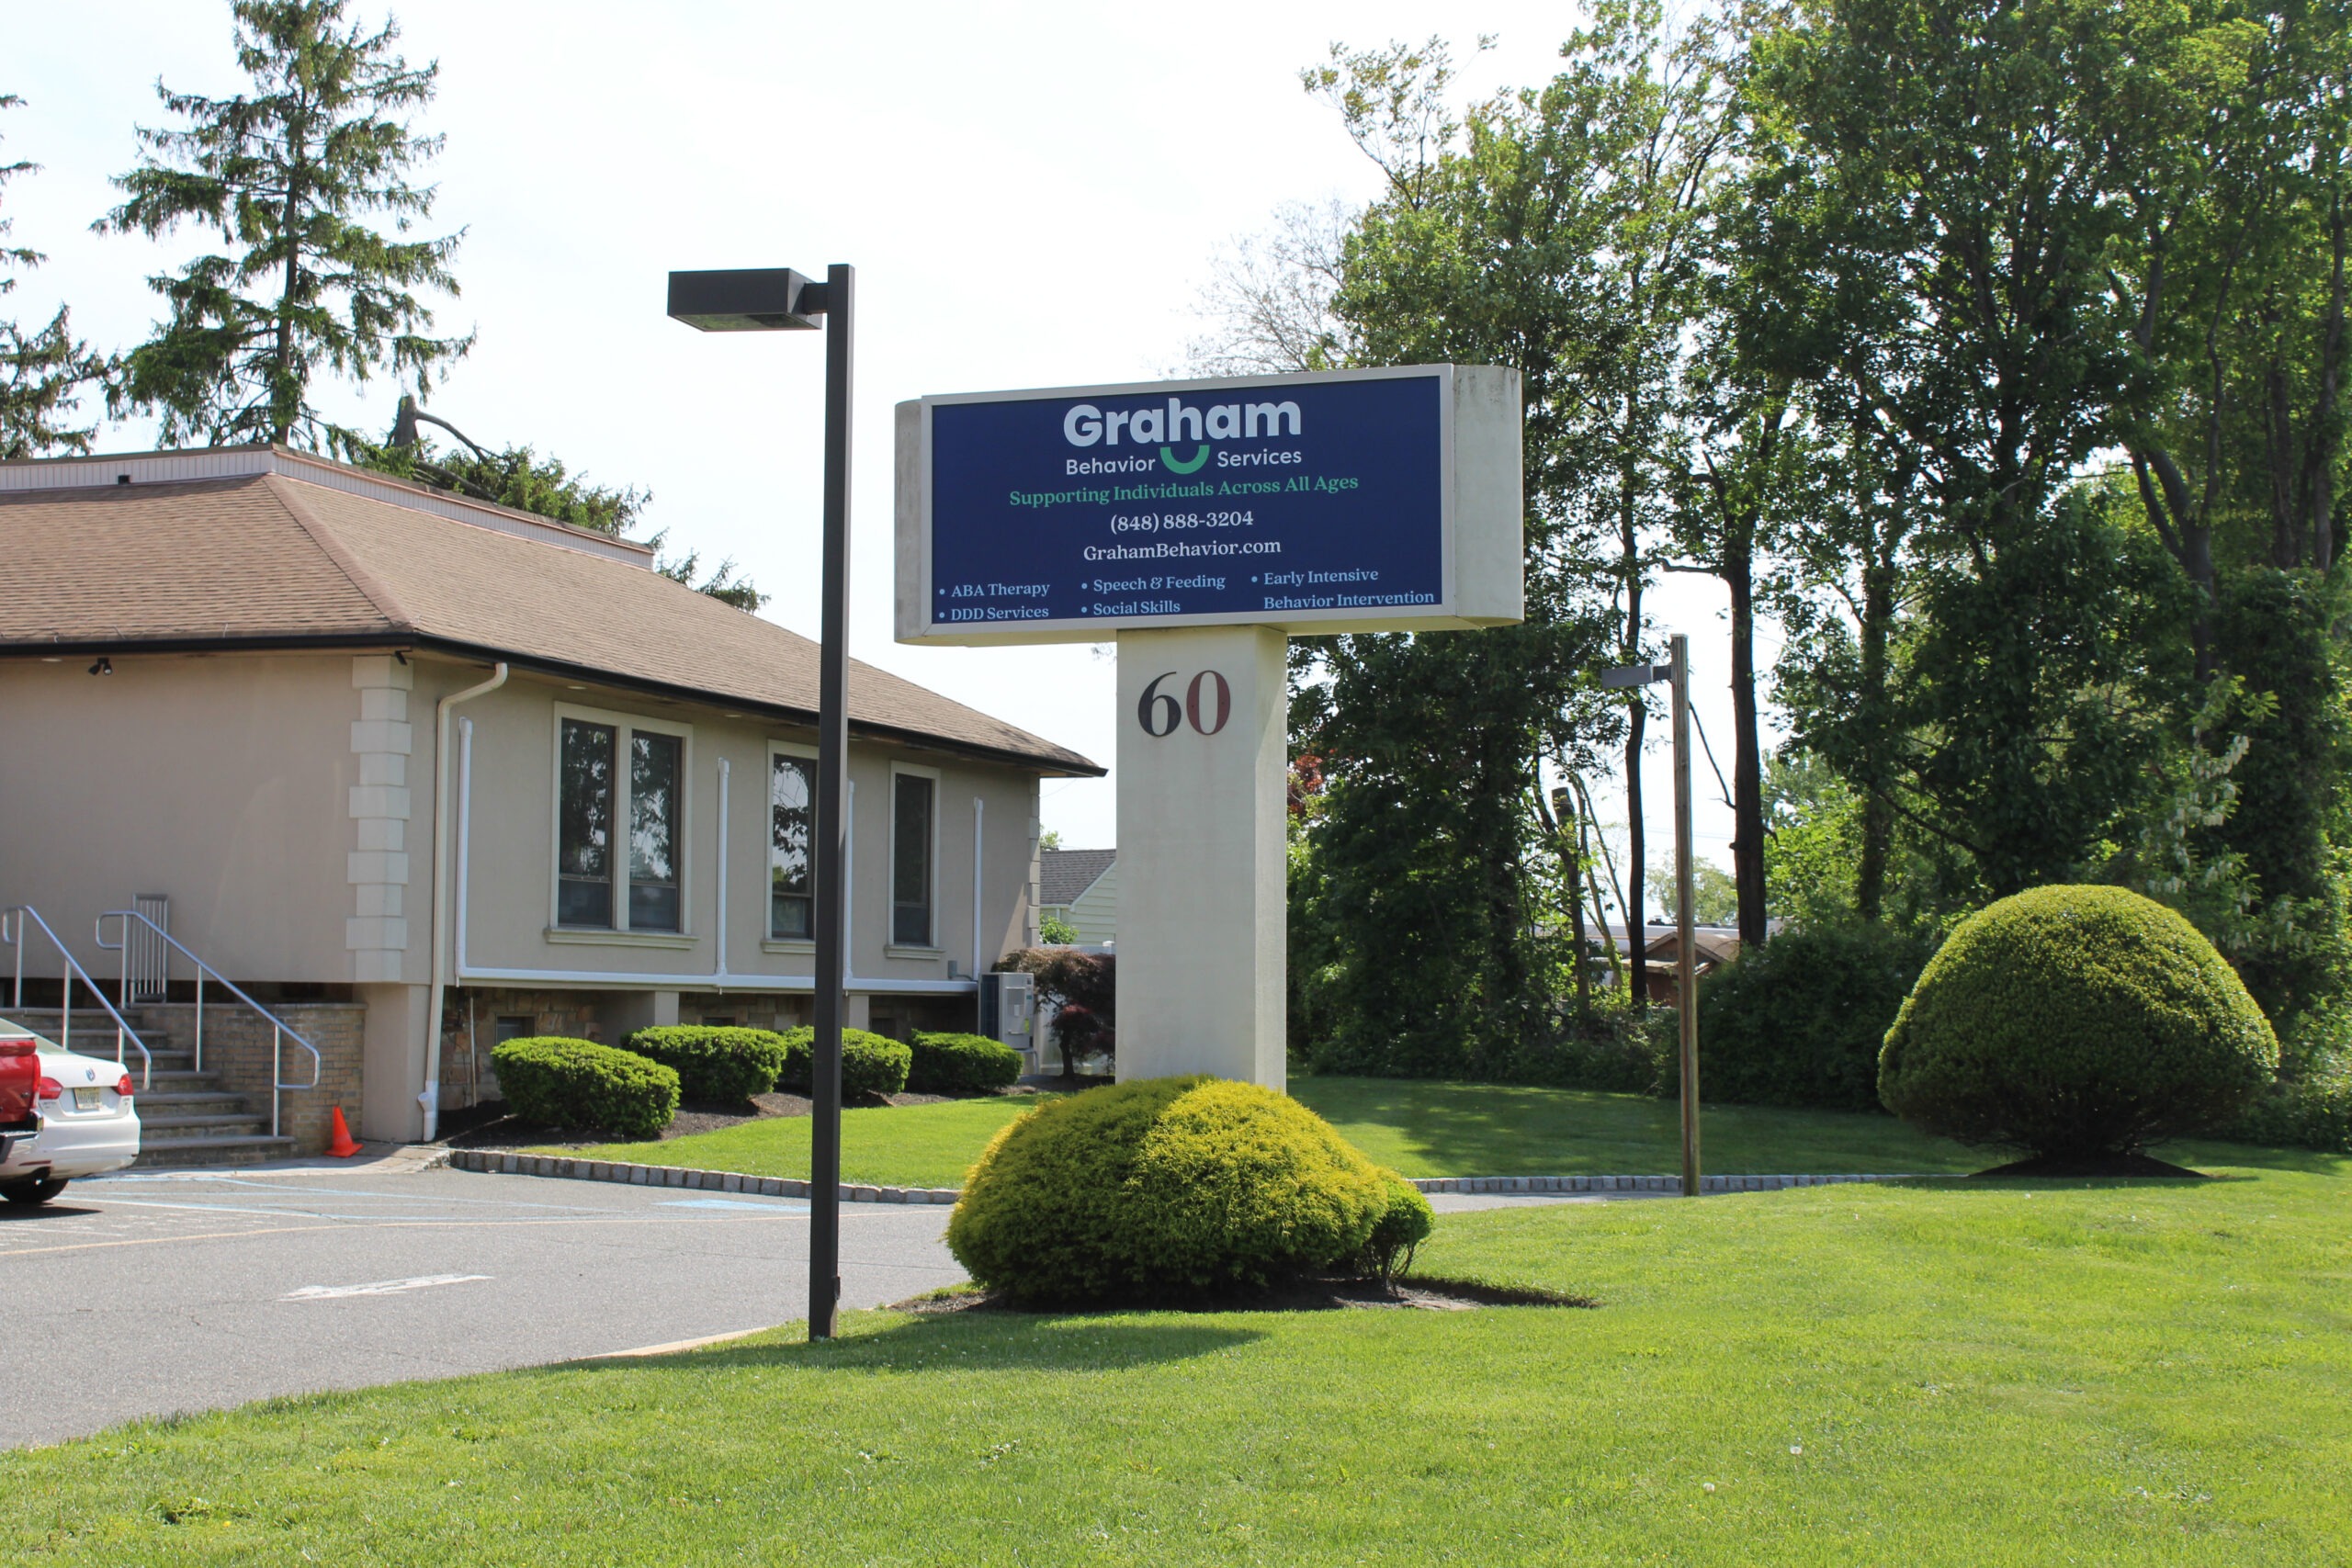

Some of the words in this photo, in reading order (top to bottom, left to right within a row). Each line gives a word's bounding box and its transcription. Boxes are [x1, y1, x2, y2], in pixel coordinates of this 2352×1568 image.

[1063, 397, 1302, 447] Graham
[1066, 456, 1157, 476] Behavior
[1216, 447, 1303, 468] Services
[1009, 483, 1111, 509] Supporting
[1114, 480, 1215, 501] Individuals
[1217, 480, 1281, 496] Across
[1283, 475, 1311, 492] All
[1313, 475, 1359, 494] Ages
[1110, 513, 1159, 536] (848)
[1162, 510, 1254, 530] 888-3204
[1083, 539, 1282, 561] GrahamBehavior.com
[1093, 577, 1148, 595] Speech
[1149, 576, 1163, 590] &
[1165, 574, 1227, 591] Feeding
[1263, 570, 1306, 588] Early
[1307, 568, 1379, 584] Intensive
[950, 584, 985, 598] ABA
[987, 582, 1051, 598] Therapy
[1263, 593, 1335, 610] Behavior
[1337, 590, 1435, 607] Intervention
[950, 607, 985, 621] DDD
[986, 604, 1050, 620] Services
[1092, 601, 1138, 616] Social
[1140, 599, 1182, 615] Skills
[1137, 669, 1231, 738] 60
